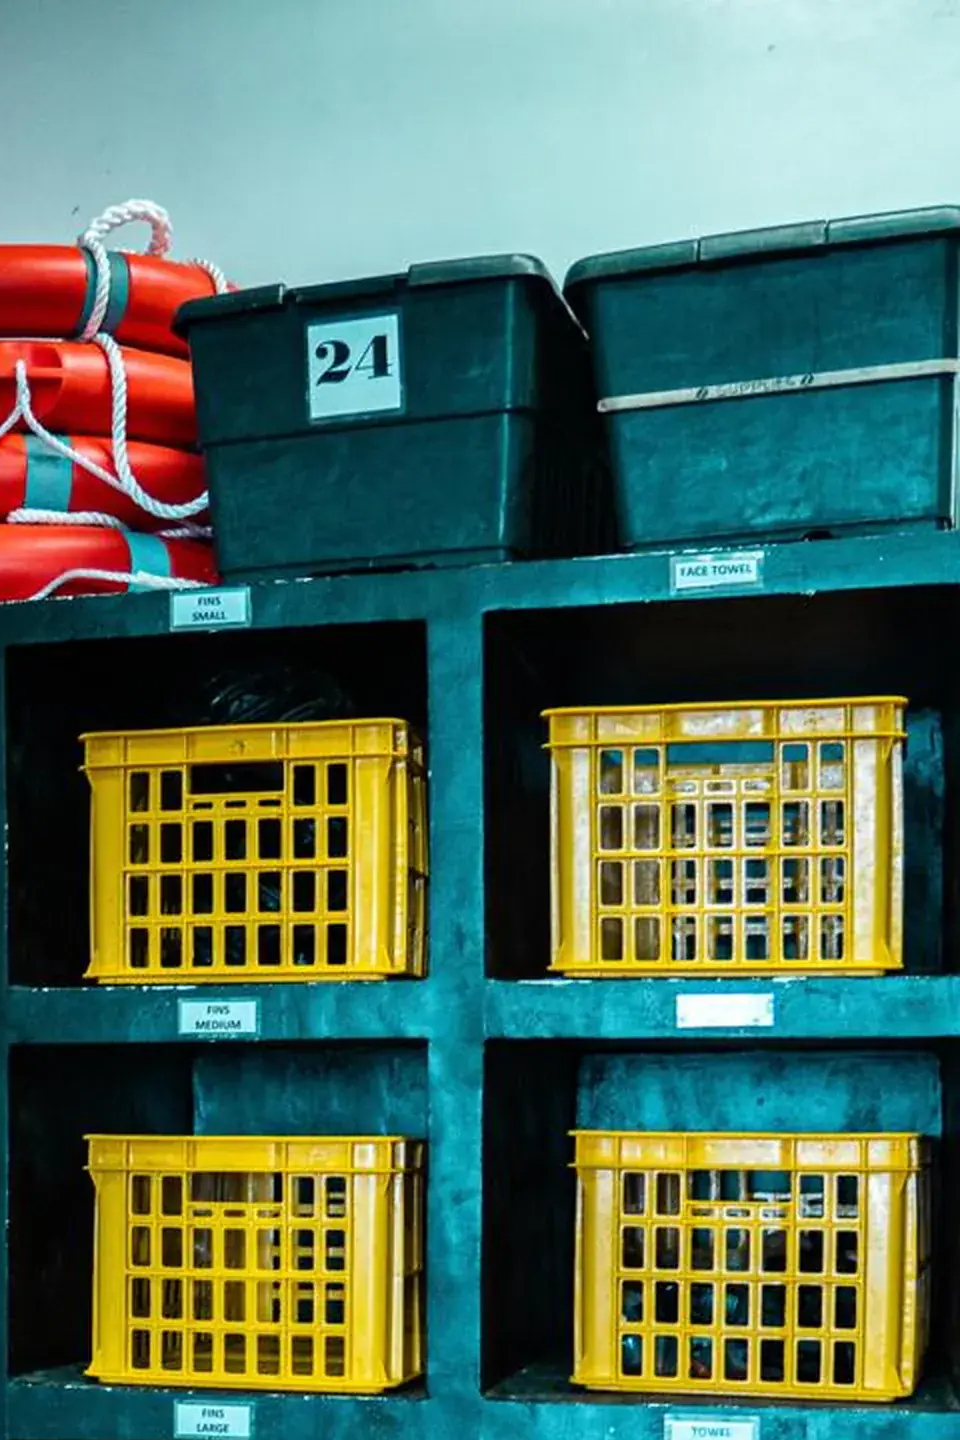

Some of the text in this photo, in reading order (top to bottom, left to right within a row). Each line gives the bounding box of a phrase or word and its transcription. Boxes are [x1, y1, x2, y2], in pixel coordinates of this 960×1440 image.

[315, 335, 394, 387] 24
[680, 563, 752, 577] FACE TOWEL
[198, 595, 221, 607] FINS
[192, 611, 227, 622] SMALL
[207, 1005, 230, 1015] FINS
[195, 1019, 241, 1030] MEDIUM
[201, 1407, 225, 1419] FINS
[196, 1423, 230, 1434] LARGE
[691, 1426, 731, 1438] TOWEL
